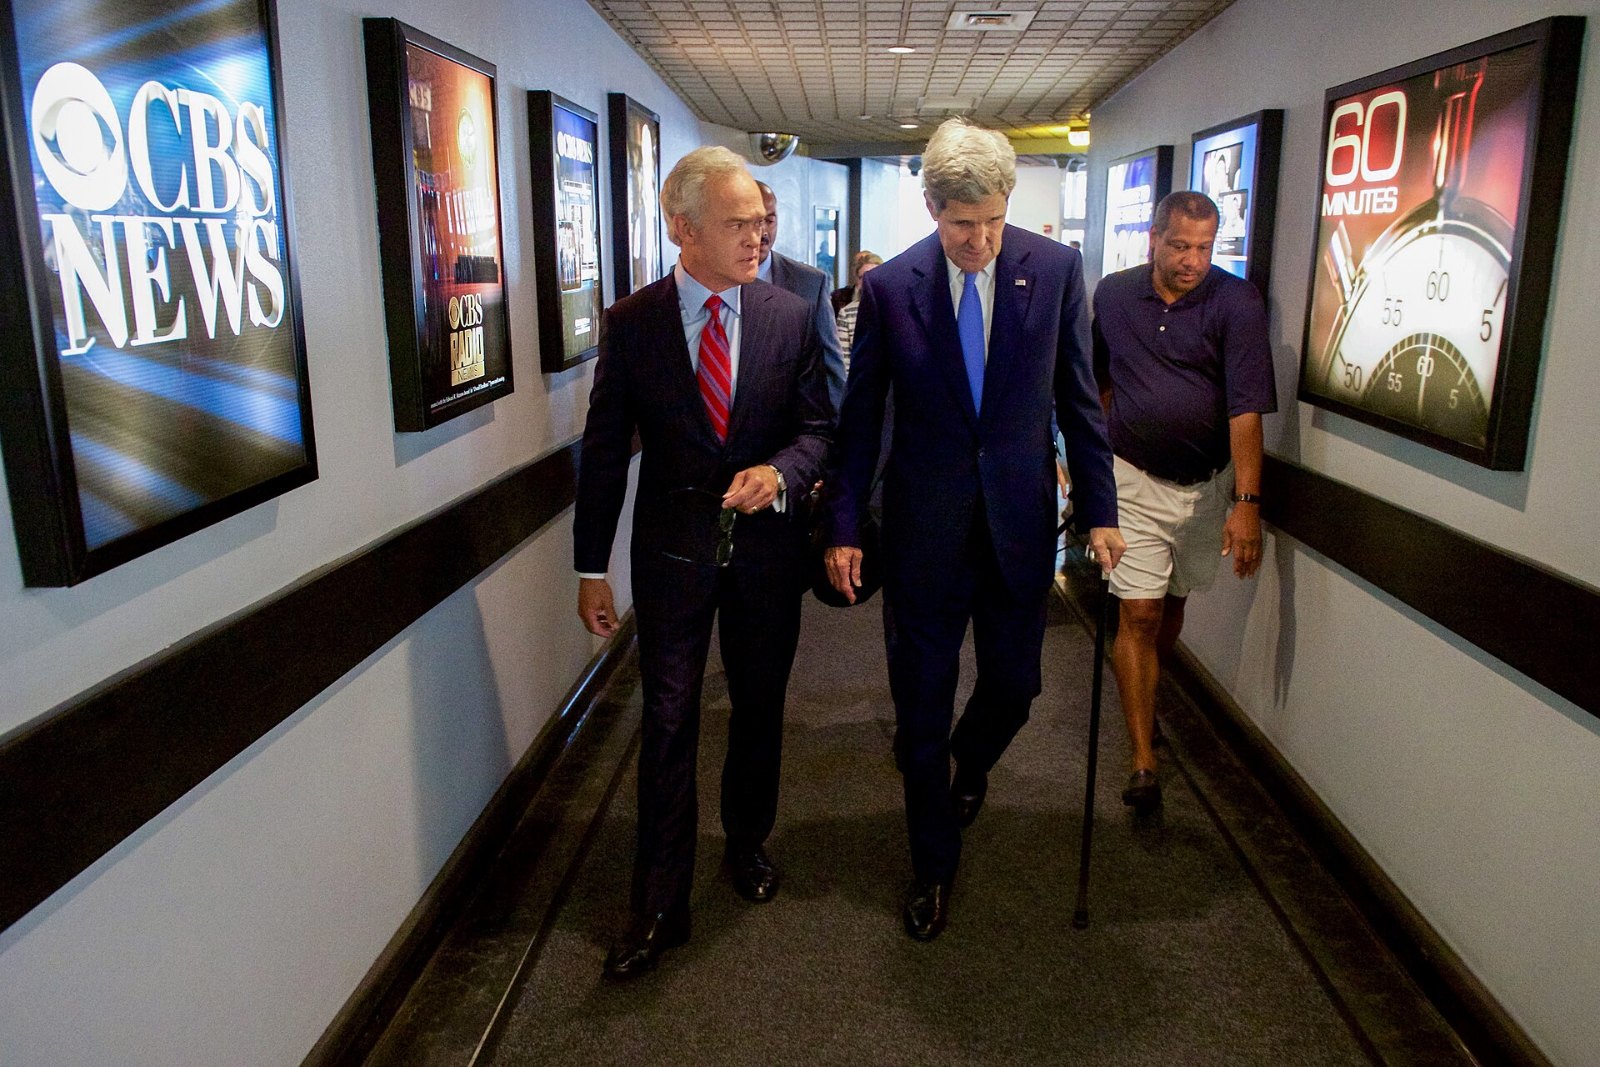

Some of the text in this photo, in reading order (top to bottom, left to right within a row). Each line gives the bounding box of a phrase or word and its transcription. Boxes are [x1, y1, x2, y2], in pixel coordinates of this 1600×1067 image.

[128, 80, 276, 217] CBS
[1325, 91, 1407, 187] 60
[1321, 186, 1398, 217] MINUTES
[42, 213, 285, 356] NEWS
[1426, 271, 1450, 302] 60
[460, 293, 483, 328] CBS
[1381, 297, 1403, 326] 55
[1479, 309, 1493, 342] 5
[450, 326, 485, 371] RADIO
[1343, 362, 1363, 392] 50
[1387, 372, 1403, 392] 55
[1416, 355, 1434, 378] 60
[1449, 388, 1459, 409] 5
